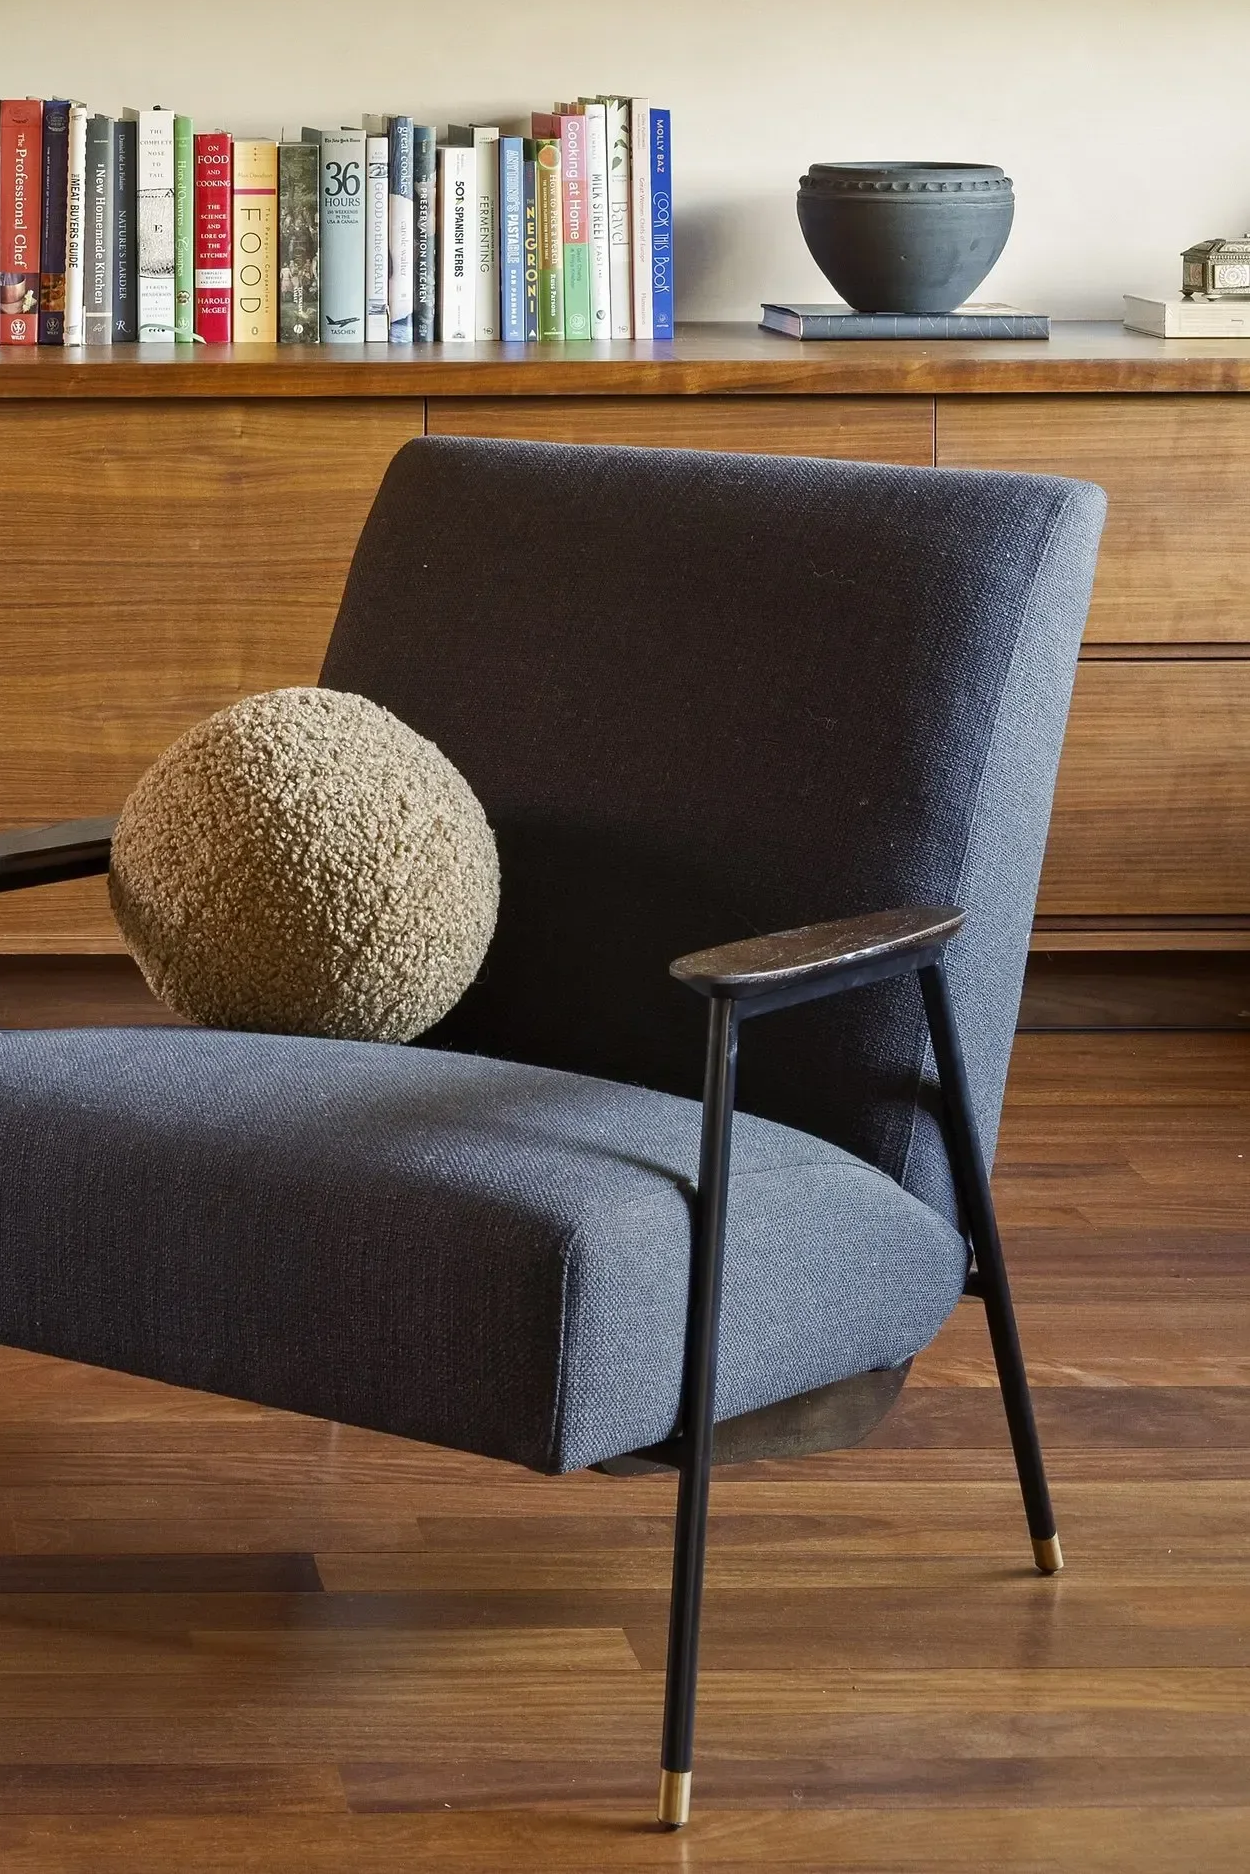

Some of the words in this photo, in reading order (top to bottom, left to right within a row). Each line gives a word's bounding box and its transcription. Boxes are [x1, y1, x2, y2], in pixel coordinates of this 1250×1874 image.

[398, 126, 409, 153] great
[566, 121, 580, 178] Cooking
[656, 120, 664, 151] MOLLY
[197, 155, 229, 164] FOOD
[400, 156, 410, 195] cookies
[657, 154, 665, 173] BAZ
[14, 148, 27, 230] Professional
[70, 178, 80, 202] MEAT
[95, 169, 105, 194] New
[324, 161, 361, 197] 36
[455, 181, 465, 202] 501
[549, 174, 558, 197] How
[568, 182, 580, 197] at
[592, 174, 603, 200] MILK
[324, 198, 360, 207] HOURS
[549, 199, 558, 208] to
[549, 210, 558, 228] Pick
[653, 191, 668, 227] COOK
[69, 204, 79, 239] BUYERS
[95, 197, 105, 259] Homemade
[118, 210, 127, 258] NATURE'S
[419, 188, 427, 258] PRESERVATION
[454, 207, 465, 245] SPANISH
[479, 195, 489, 273] FERMENTING
[569, 199, 581, 240] Home
[593, 203, 604, 240] STREET
[611, 201, 629, 246] Bavel
[14, 234, 27, 266] Chef
[69, 242, 78, 269] GUIDE
[240, 208, 262, 313] FOOD
[454, 247, 464, 277] VERBS
[550, 239, 559, 265] Peach
[94, 262, 105, 304] Kitchen
[119, 261, 127, 300] LARDER
[419, 261, 427, 303] KITCHEN
[549, 274, 557, 291] Russ
[654, 256, 669, 293] BOOK
[550, 293, 558, 316] Parsons
